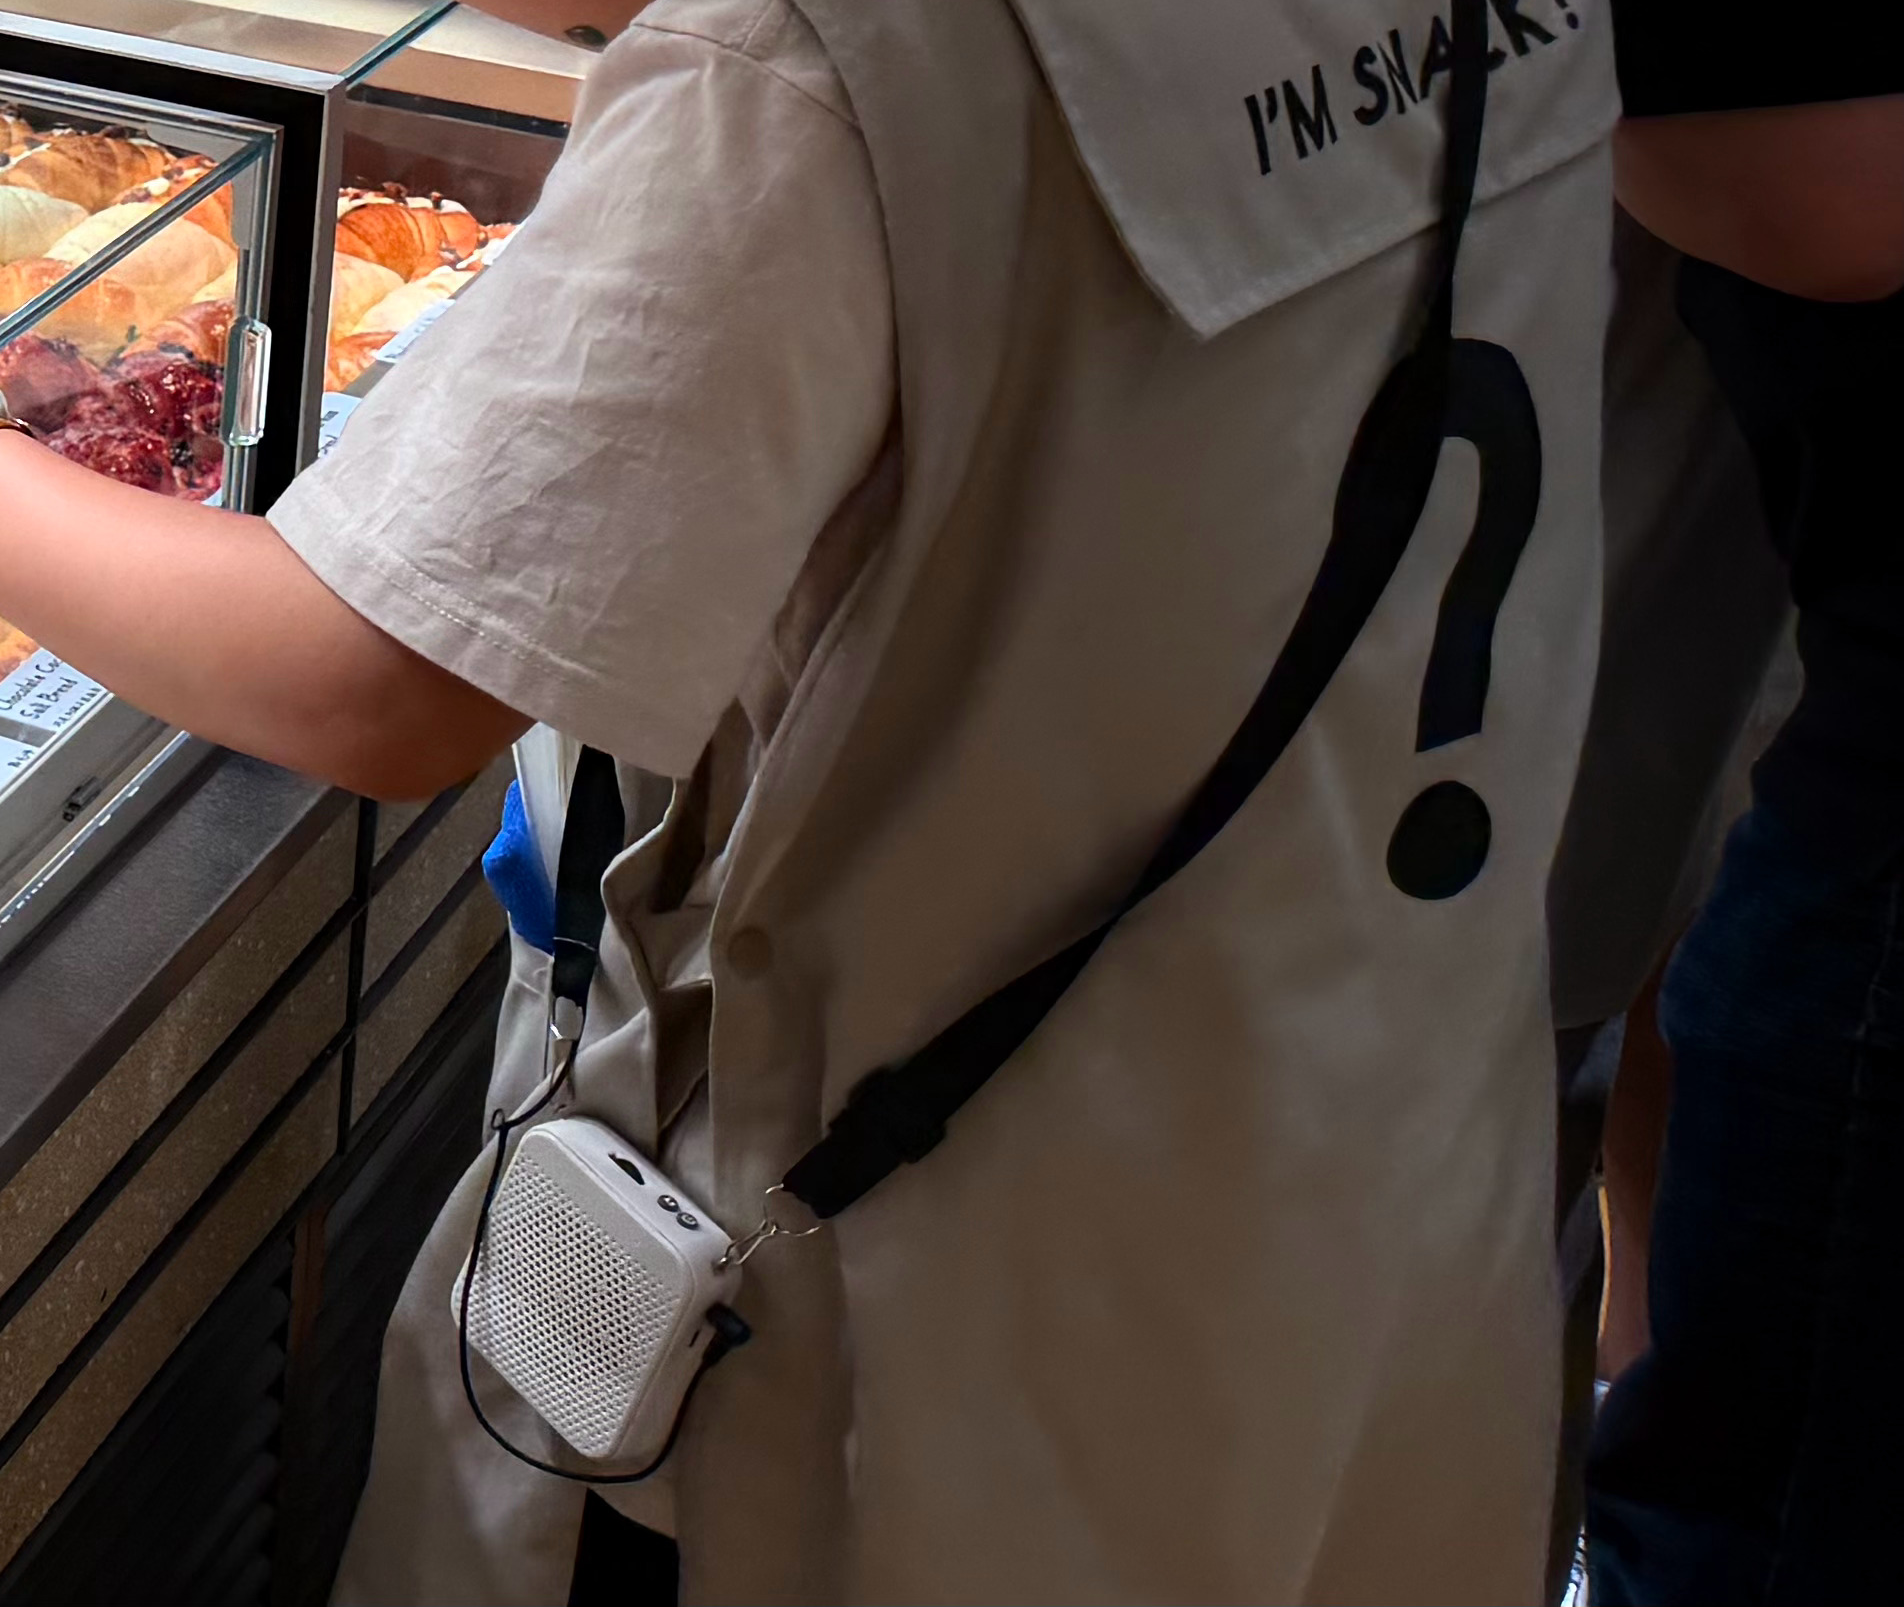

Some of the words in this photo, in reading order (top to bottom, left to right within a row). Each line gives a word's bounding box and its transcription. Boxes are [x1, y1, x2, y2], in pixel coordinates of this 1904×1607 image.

[1244, 64, 1338, 176] I'M
[20, 701, 52, 720] Salt
[37, 677, 78, 703] Bread
